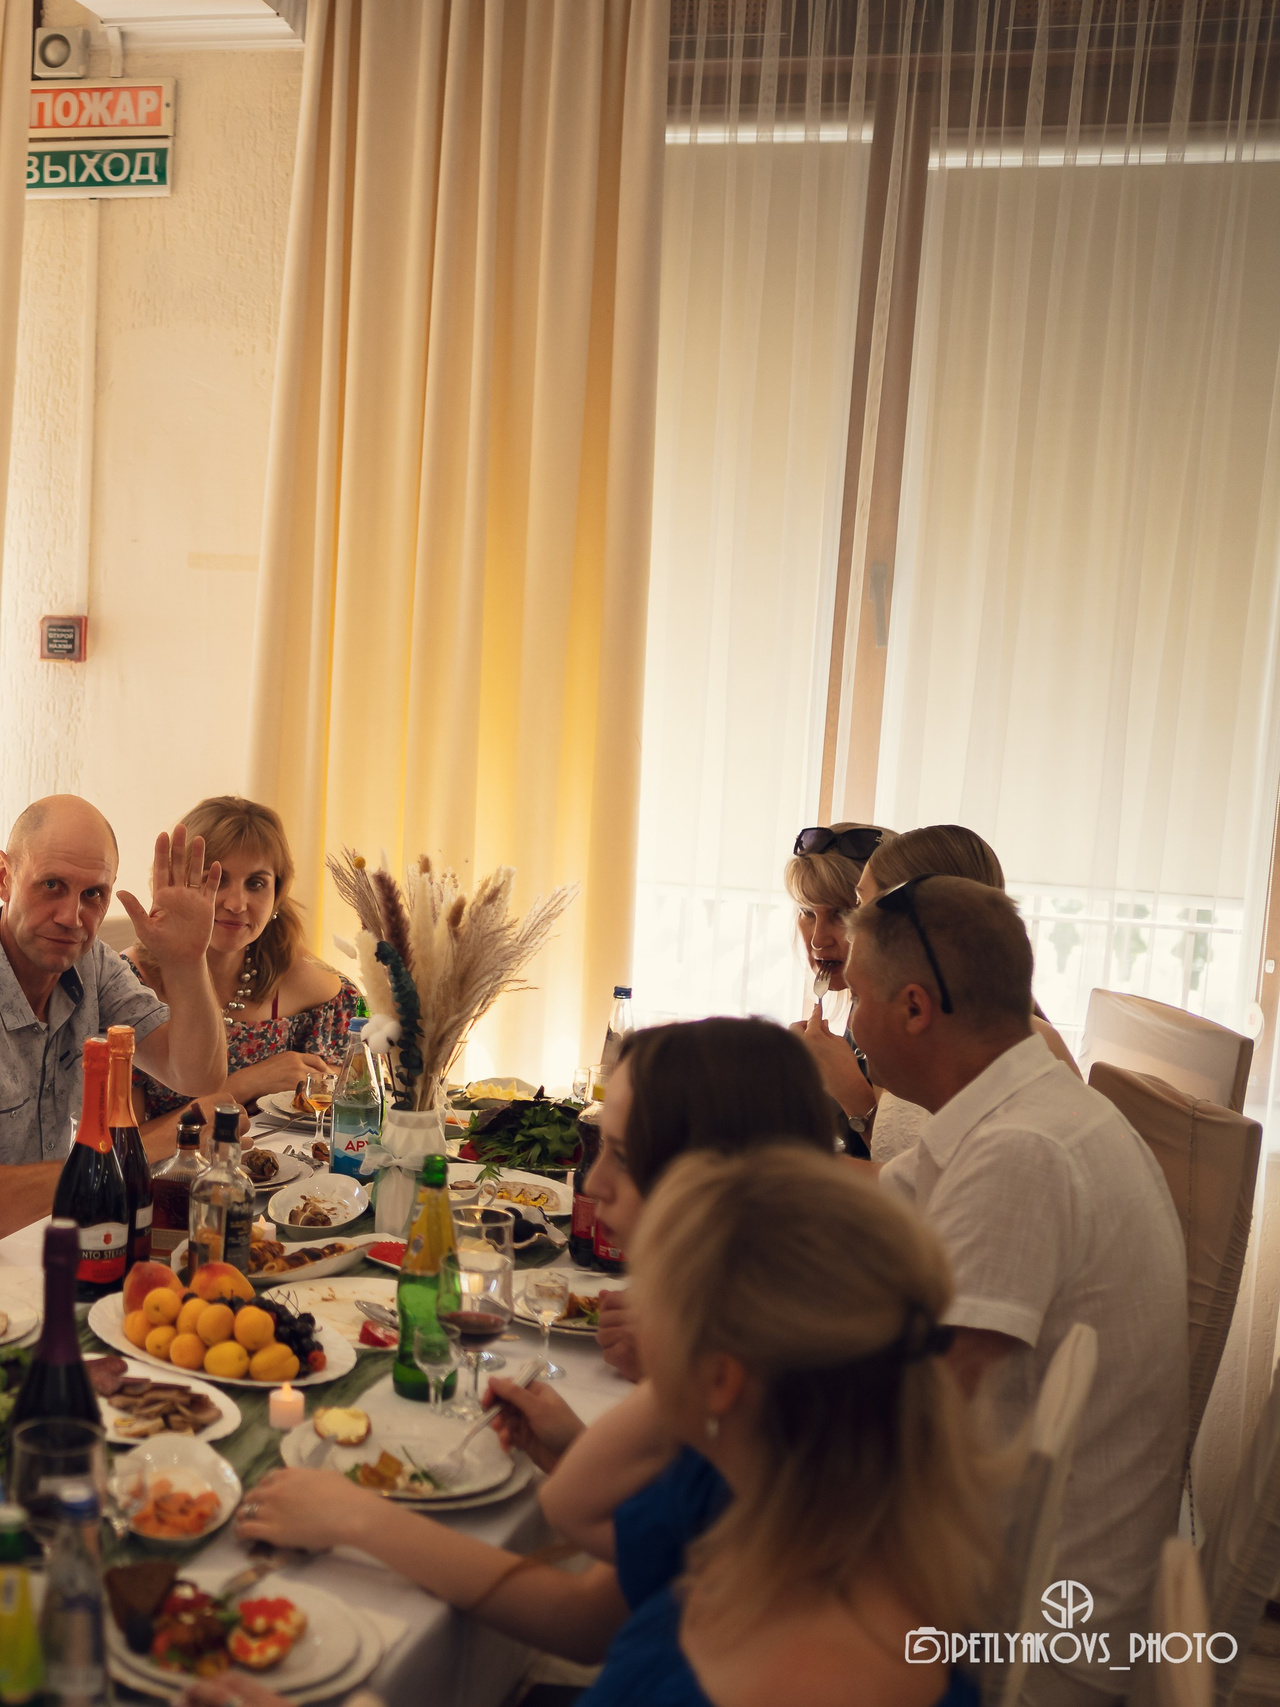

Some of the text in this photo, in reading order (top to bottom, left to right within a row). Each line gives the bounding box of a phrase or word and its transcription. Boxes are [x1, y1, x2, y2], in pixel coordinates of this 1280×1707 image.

[30, 90, 160, 127] ПОЖАР
[344, 1140, 369, 1152] АР
[81, 1250, 101, 1260] NTO
